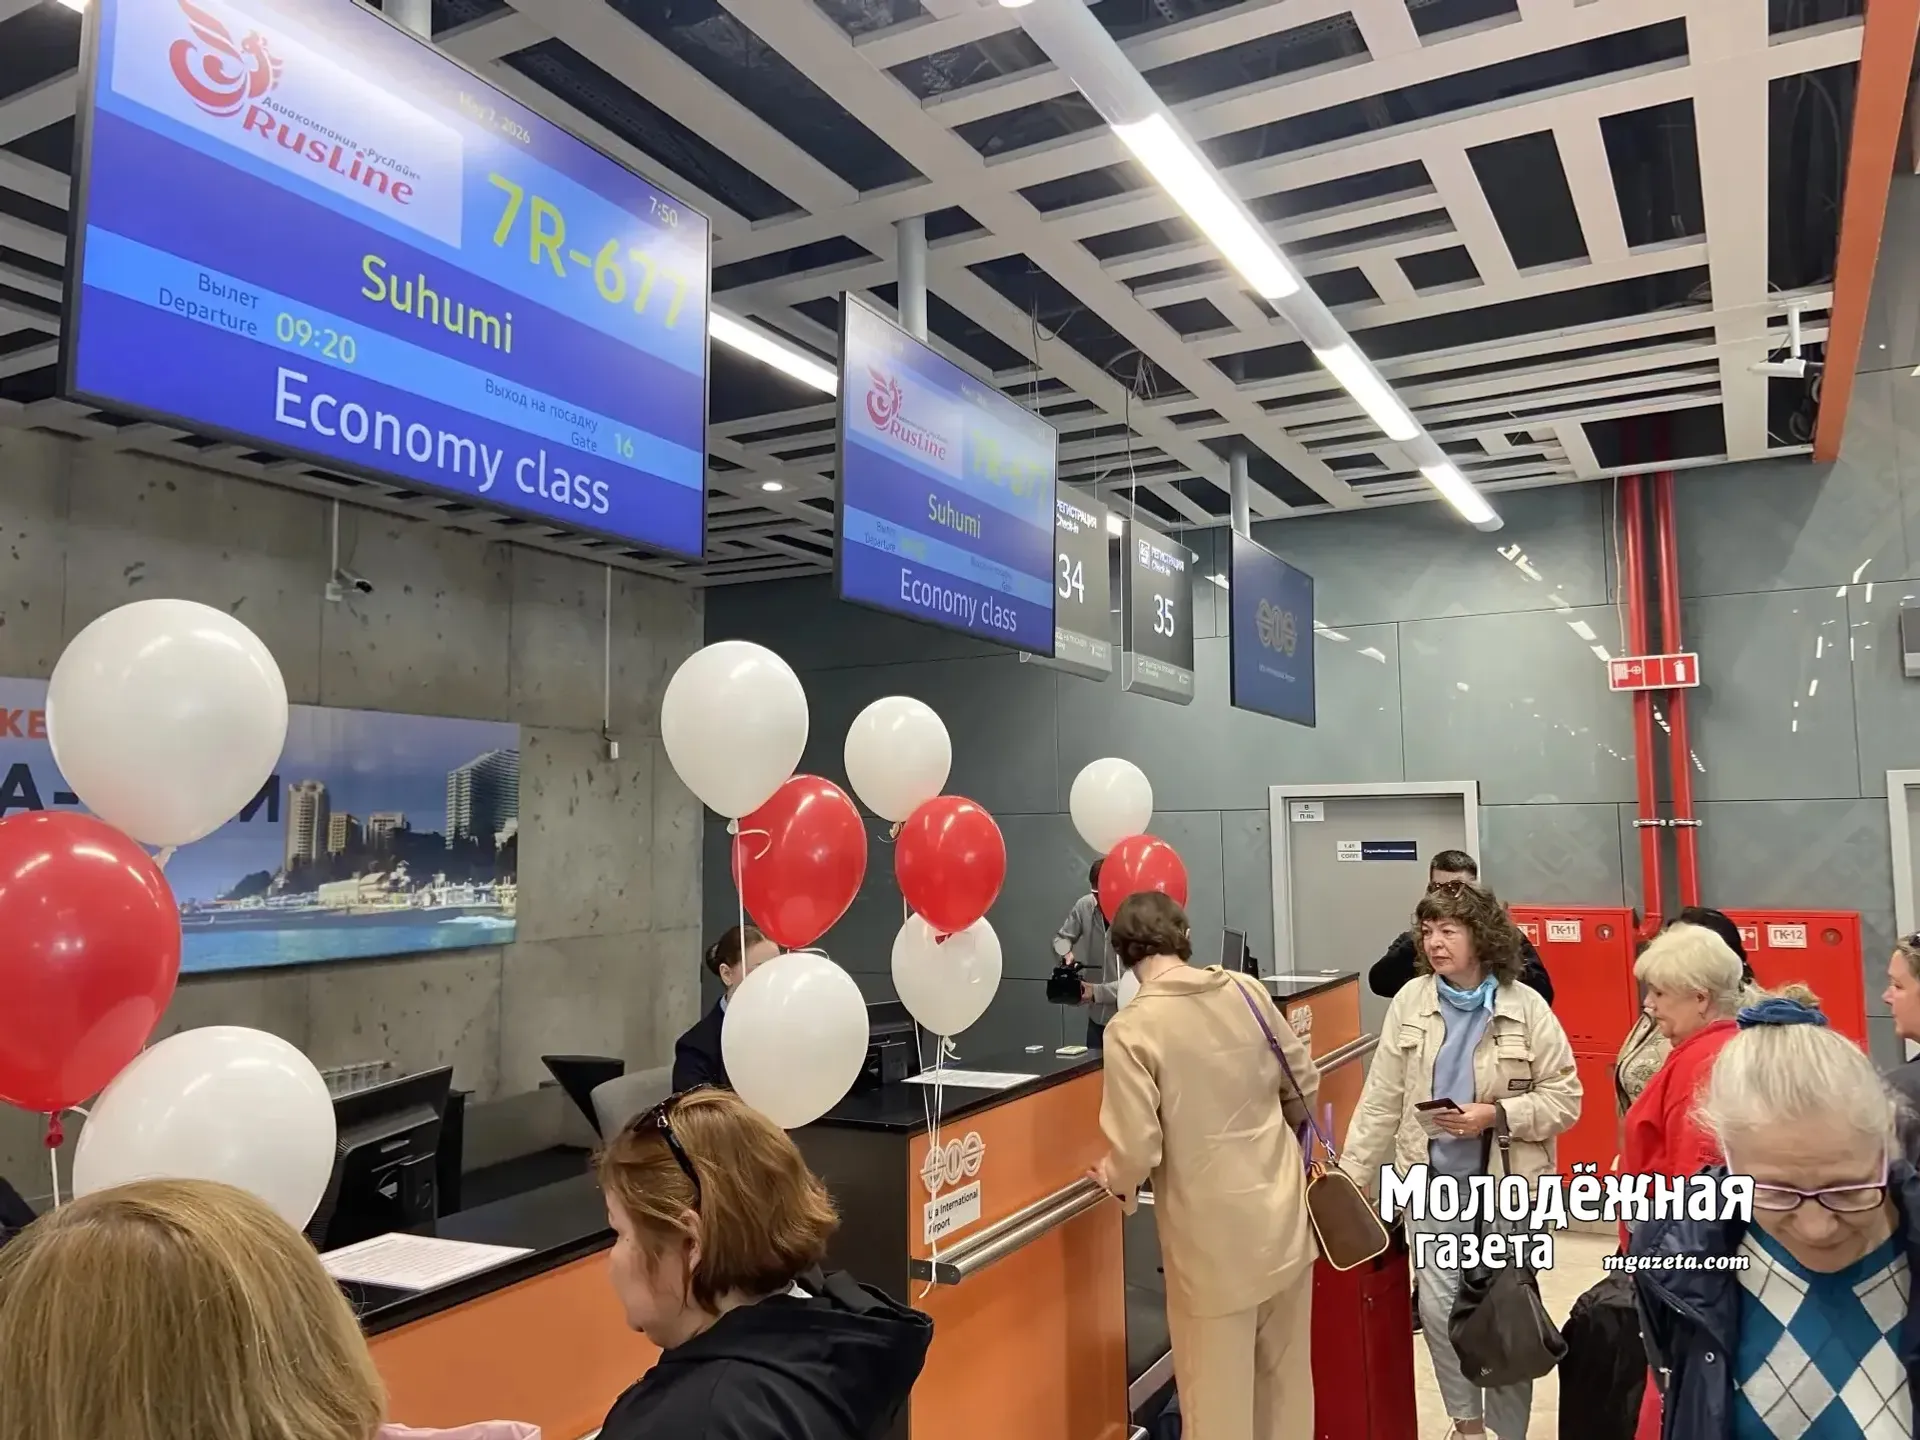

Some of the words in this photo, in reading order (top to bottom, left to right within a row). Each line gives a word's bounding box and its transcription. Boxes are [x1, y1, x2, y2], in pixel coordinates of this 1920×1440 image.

[262, 96, 357, 150] Авиакомпания
[501, 116, 531, 144] 2026
[242, 104, 414, 205] RusLine
[649, 195, 679, 228] 7:50
[488, 171, 689, 329] 7R-677
[159, 287, 258, 336] Departure
[199, 273, 259, 309] Вылет
[361, 254, 513, 354] Suhumi
[276, 312, 356, 364] 09:20
[485, 378, 528, 408] Выход
[531, 398, 546, 413] на
[551, 405, 598, 434] посадку
[275, 366, 503, 492] Economy
[516, 449, 610, 514] class
[571, 431, 598, 452] Gate
[614, 433, 634, 459] 16
[889, 419, 946, 460] RusLine
[928, 494, 981, 539] Suhumi
[901, 568, 977, 627] Economy
[981, 596, 1017, 632] class
[1058, 553, 1085, 604] 34
[1153, 594, 1175, 638] 35
[1551, 925, 1576, 934] ПК-11
[1773, 929, 1803, 940] ПК-12
[928, 1207, 939, 1219] Ua
[940, 1188, 978, 1214] International
